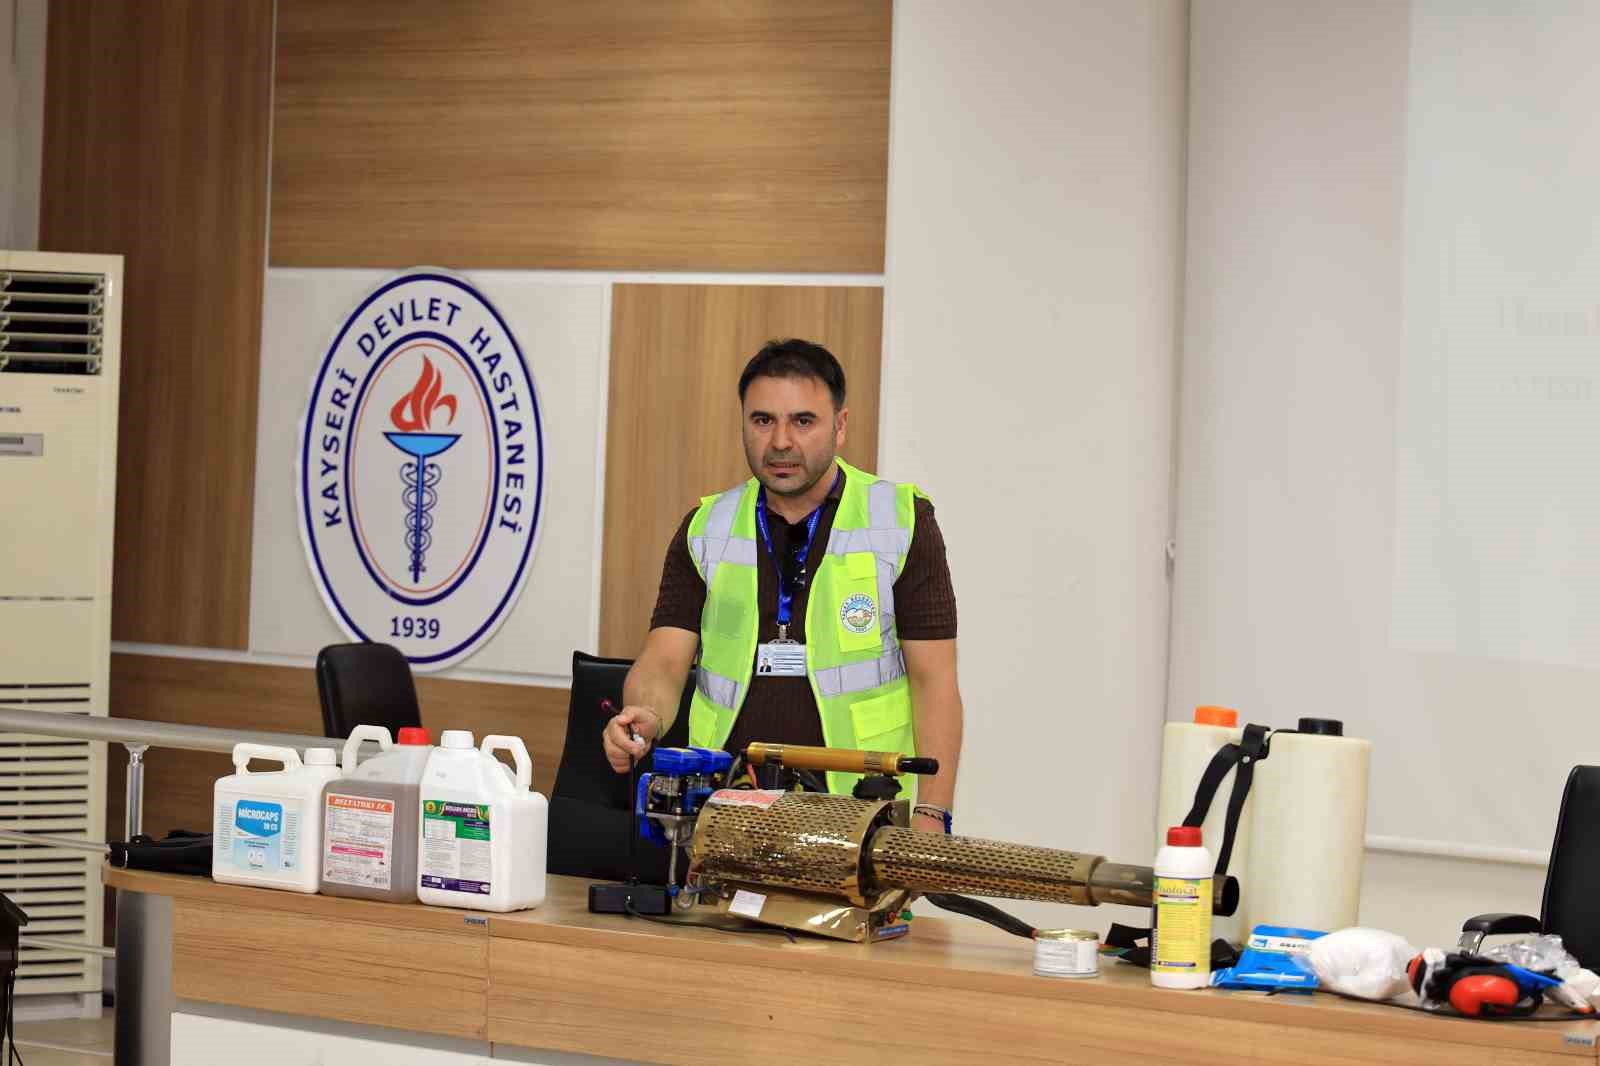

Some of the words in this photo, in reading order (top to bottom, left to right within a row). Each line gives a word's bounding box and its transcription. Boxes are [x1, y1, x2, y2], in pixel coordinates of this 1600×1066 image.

[320, 368, 357, 528] KAYSERİ
[356, 298, 462, 358] DEVLET
[470, 326, 526, 535] HASTANESİ
[390, 616, 441, 640] 1939
